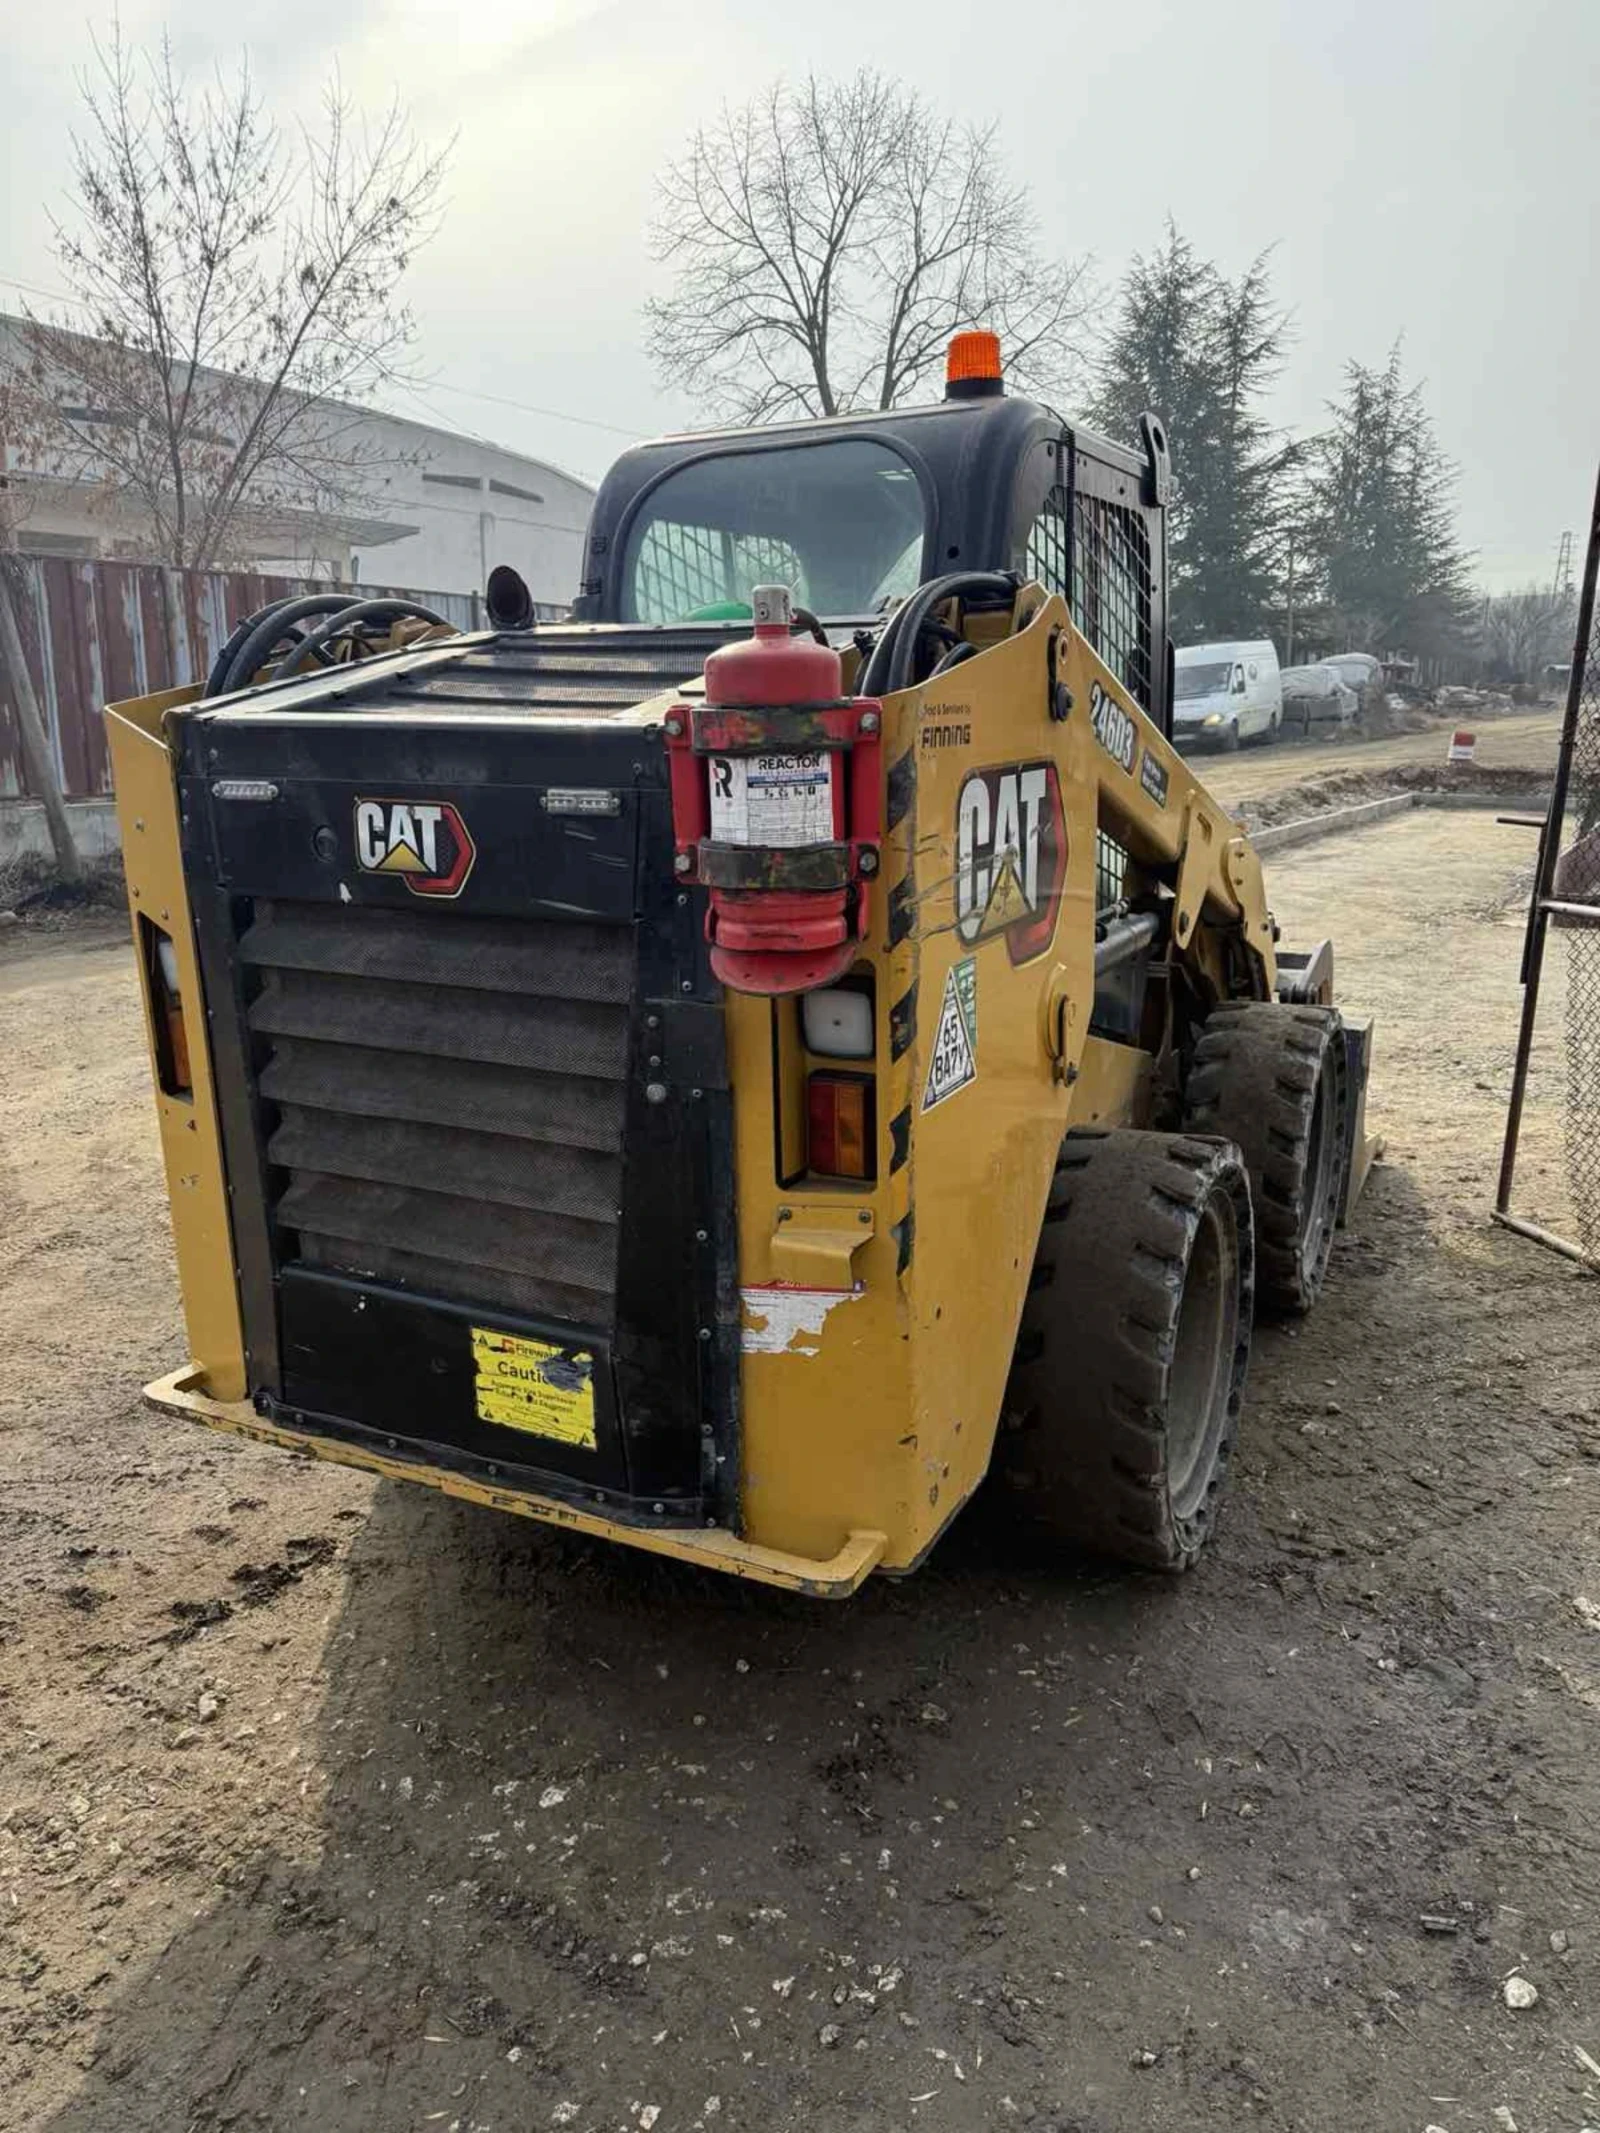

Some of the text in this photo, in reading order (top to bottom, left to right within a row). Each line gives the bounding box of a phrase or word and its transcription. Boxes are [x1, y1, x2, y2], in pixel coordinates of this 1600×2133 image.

[758, 757, 820, 770] REACTON
[358, 802, 441, 873] CAT
[959, 768, 1046, 939] CAT
[942, 1014, 958, 1046] 65
[497, 1361, 550, 1386] Cauti
